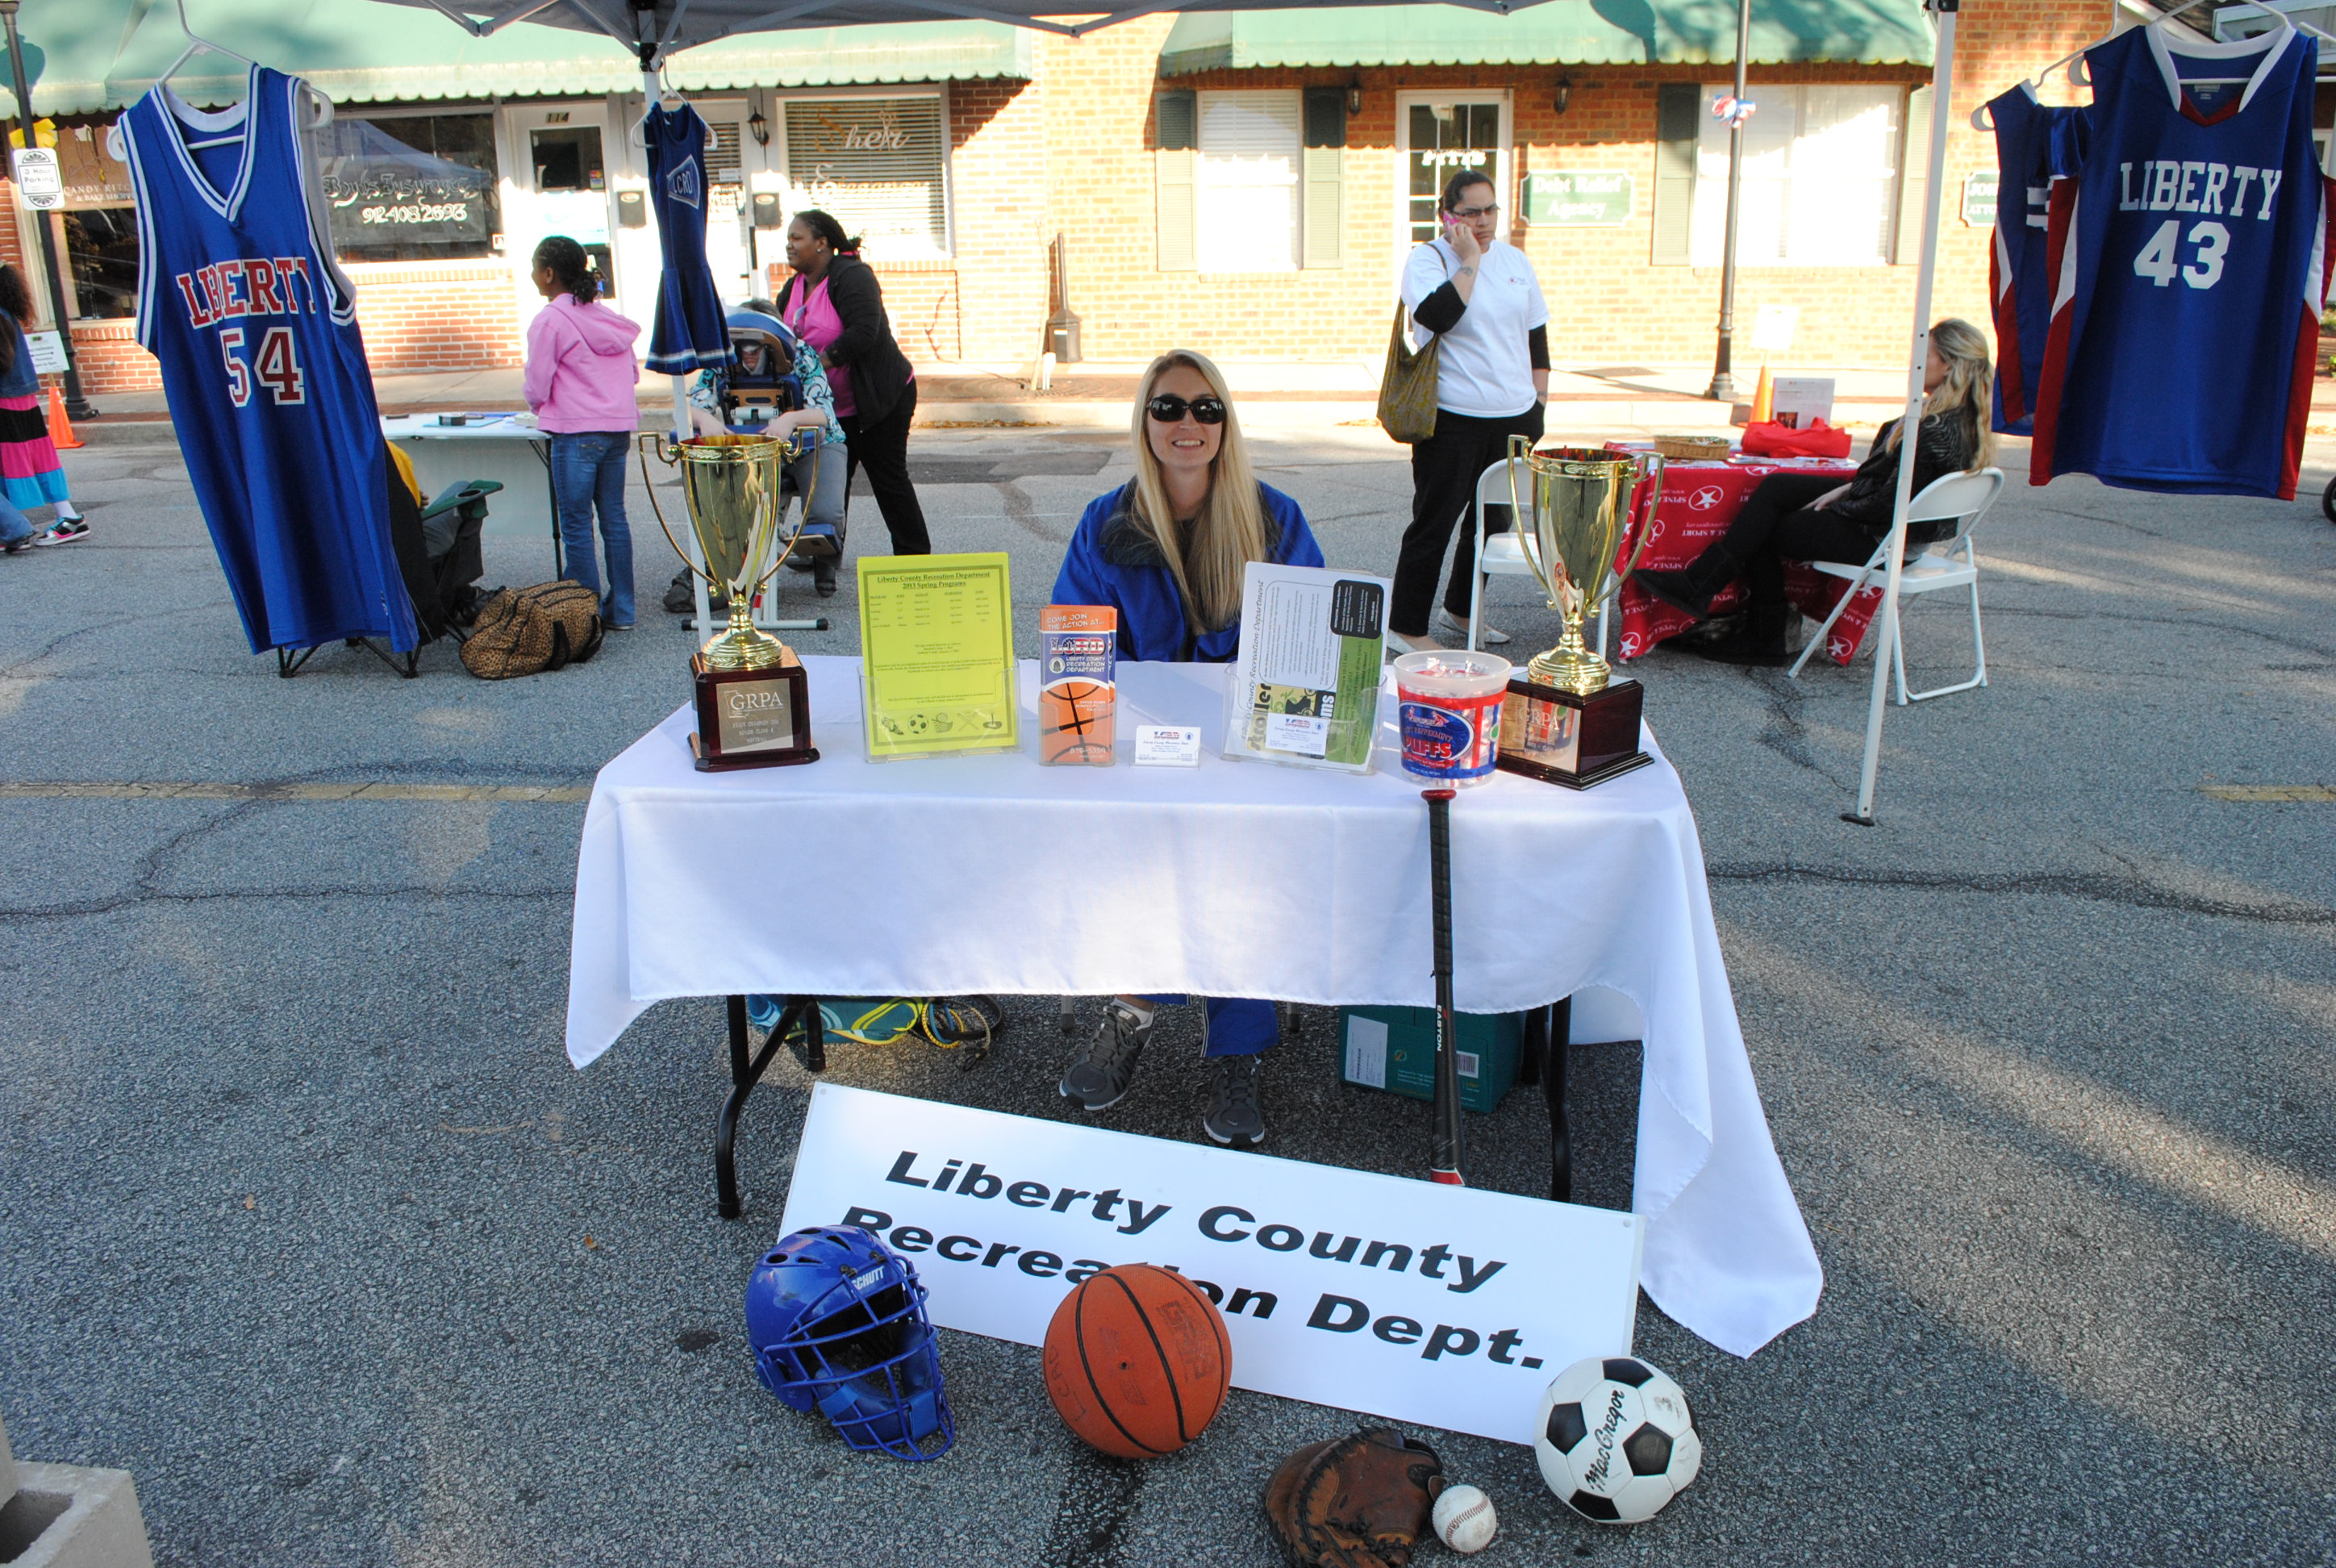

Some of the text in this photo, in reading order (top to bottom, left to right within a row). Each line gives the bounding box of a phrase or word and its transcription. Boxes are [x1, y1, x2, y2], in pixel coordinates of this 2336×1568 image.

[548, 112, 569, 123] 114
[63, 183, 131, 196] CANDY KITC
[673, 170, 693, 194] LCRD
[1534, 174, 1623, 193] Debt Relief
[2119, 161, 2282, 221] LIBERTY
[85, 194, 103, 202] BAKE
[1547, 200, 1607, 220] Agency
[2134, 219, 2230, 290] 43
[219, 327, 306, 407] 54
[1664, 496, 1687, 504] SPINE
[1682, 528, 1708, 537] SPORT
[1659, 562, 1683, 570] SPINE
[899, 574, 922, 582] County
[923, 573, 955, 581] Recreation
[956, 571, 991, 580] Department
[903, 580, 967, 590] 2013 Spring Programs
[1254, 579, 1266, 632] Department
[1047, 613, 1087, 623] COME JOIN
[1062, 621, 1088, 629] ACTION
[1049, 637, 1107, 655] LCRD
[1249, 632, 1261, 679] Recreation
[730, 691, 784, 711] GRPA
[1245, 680, 1257, 710] County
[1320, 695, 1335, 719] ms
[1518, 706, 1560, 731] GRPA
[1404, 735, 1452, 759] PUFFS
[885, 1150, 1508, 1293] Liberty County
[841, 1206, 1279, 1320] Recreaon
[1306, 1292, 1544, 1370] Dept.
[1583, 1390, 1628, 1492] MacGregor
